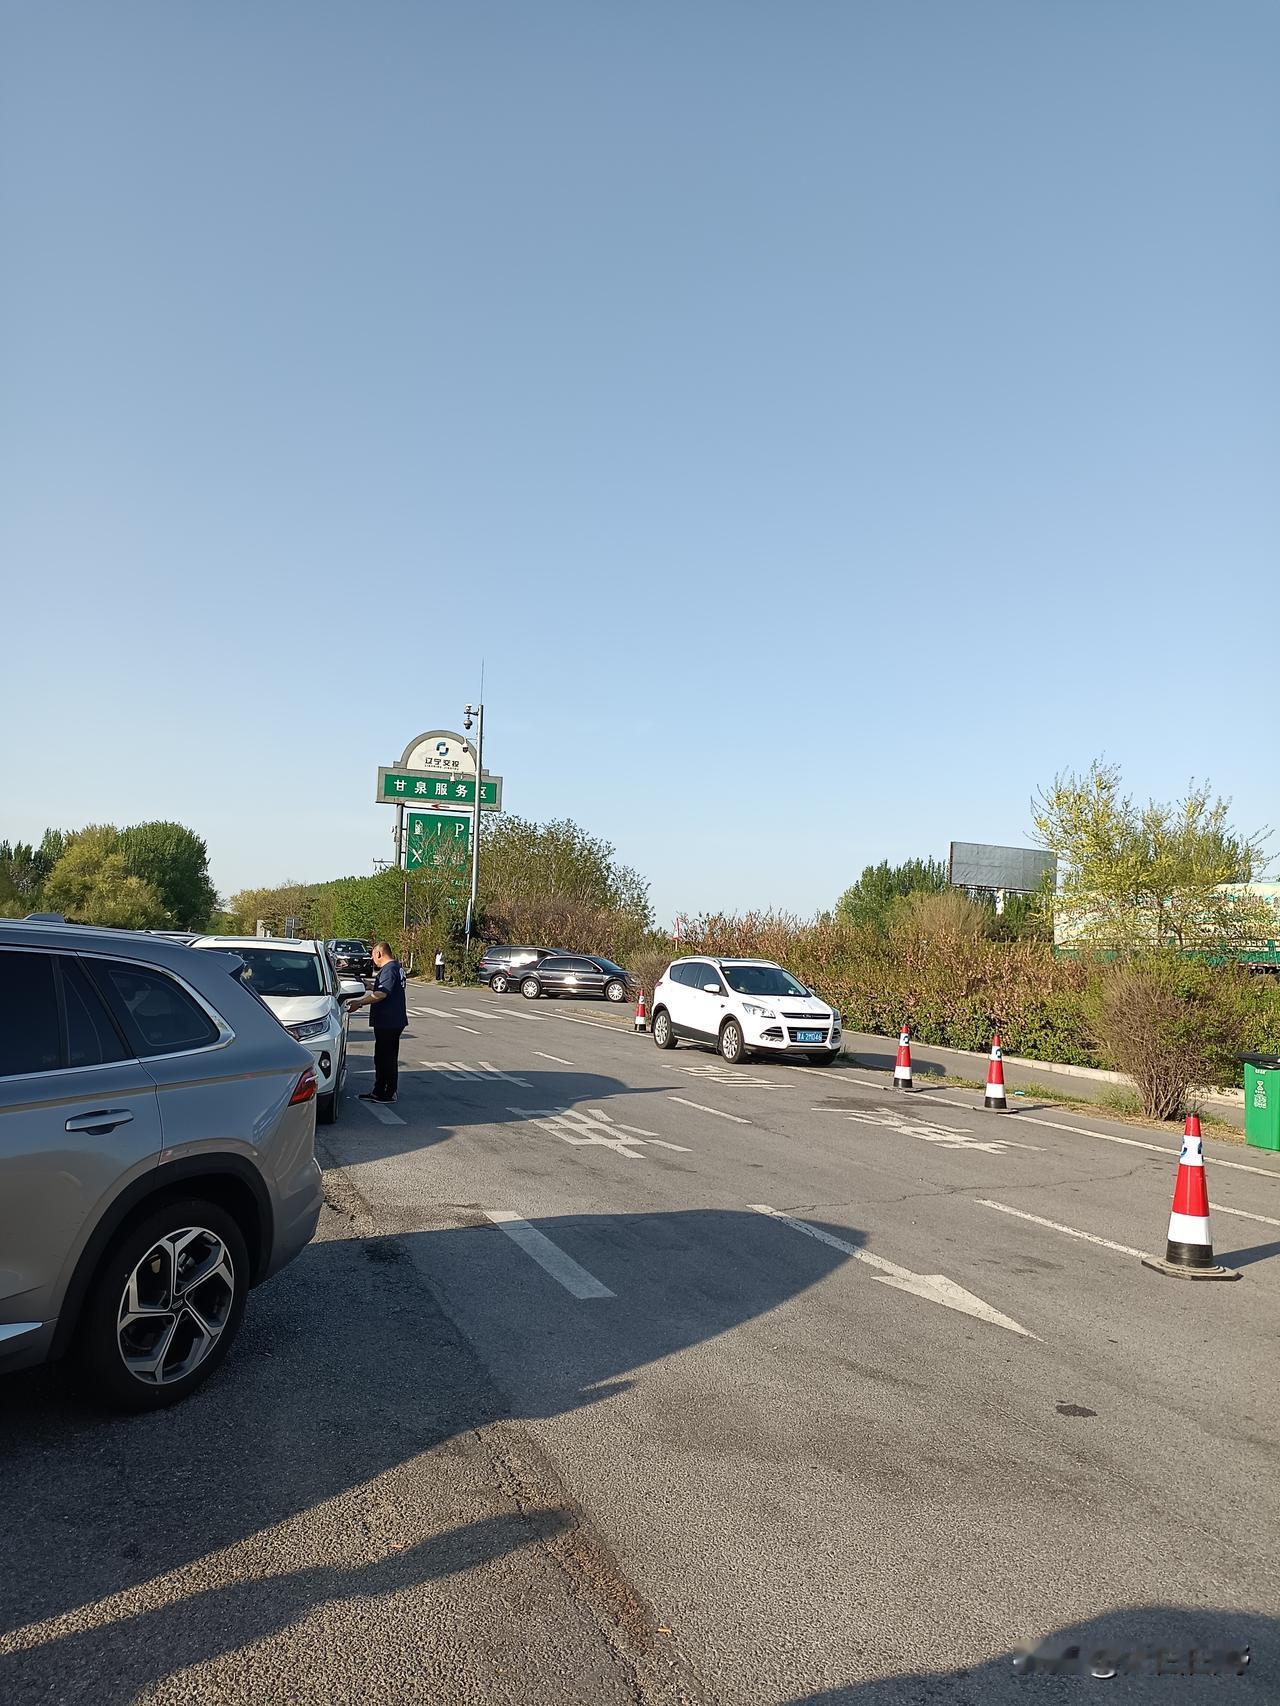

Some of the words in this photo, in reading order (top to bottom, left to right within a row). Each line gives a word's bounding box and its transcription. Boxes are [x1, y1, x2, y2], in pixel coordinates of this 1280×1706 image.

[425, 757, 460, 768] 辽宁交投
[394, 780, 487, 799] 甘泉服务区
[454, 823, 465, 838] P
